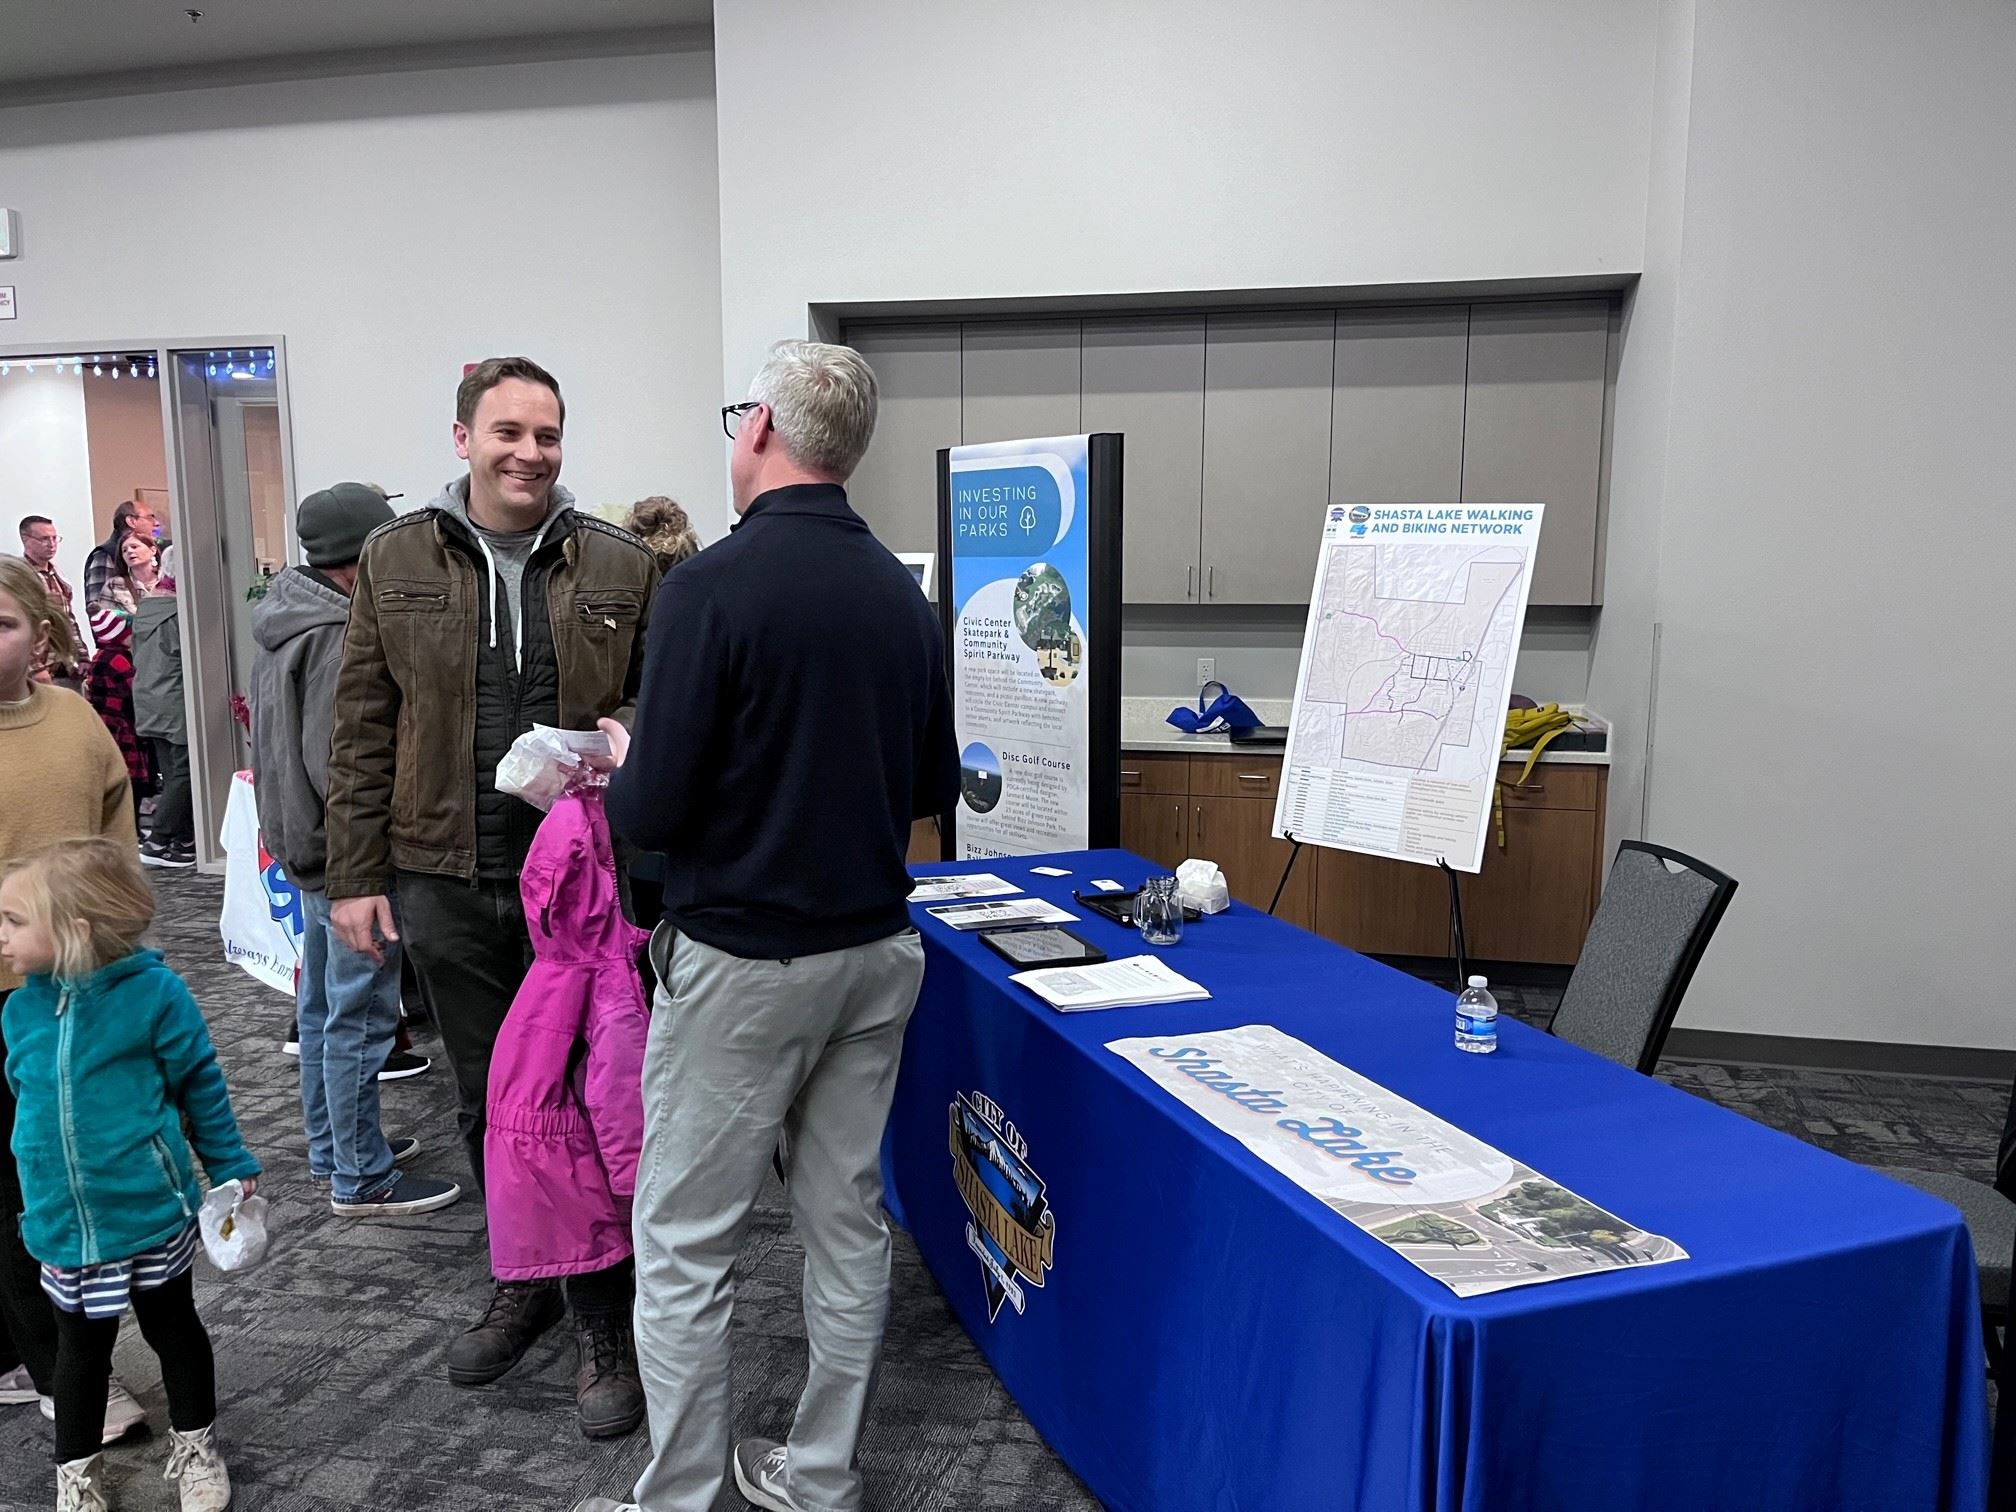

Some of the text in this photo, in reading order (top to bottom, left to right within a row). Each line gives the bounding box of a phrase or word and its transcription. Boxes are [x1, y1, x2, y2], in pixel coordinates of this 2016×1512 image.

[959, 486, 1037, 503] INVESTING
[959, 505, 1008, 520] IN OUR
[1373, 510, 1533, 521] SHASTA LAKE WALKING
[959, 523, 1008, 537] PARKS
[1371, 523, 1523, 535] AND BIKING NETWORK
[963, 616, 1012, 628] Civic Center
[963, 628, 1010, 639] Skatepark &
[963, 639, 1008, 651] Community
[963, 649, 1021, 664] Spirit Parkway
[1002, 751, 1071, 771] Disc Golf Course
[966, 843, 1013, 858] Bizz Johns
[225, 939, 269, 966] lways
[1150, 1047, 1288, 1114] Shasta
[1293, 1082, 1355, 1115] CITY OF
[1307, 1073, 1391, 1120] HAPPENING
[1391, 1121, 1416, 1133] IN
[1417, 1136, 1453, 1153] THE
[972, 1091, 1028, 1160] CITY OF
[1277, 1116, 1417, 1186] Lake
[957, 1153, 1001, 1243] SHASTA
[1004, 1218, 1040, 1276] LAKE
